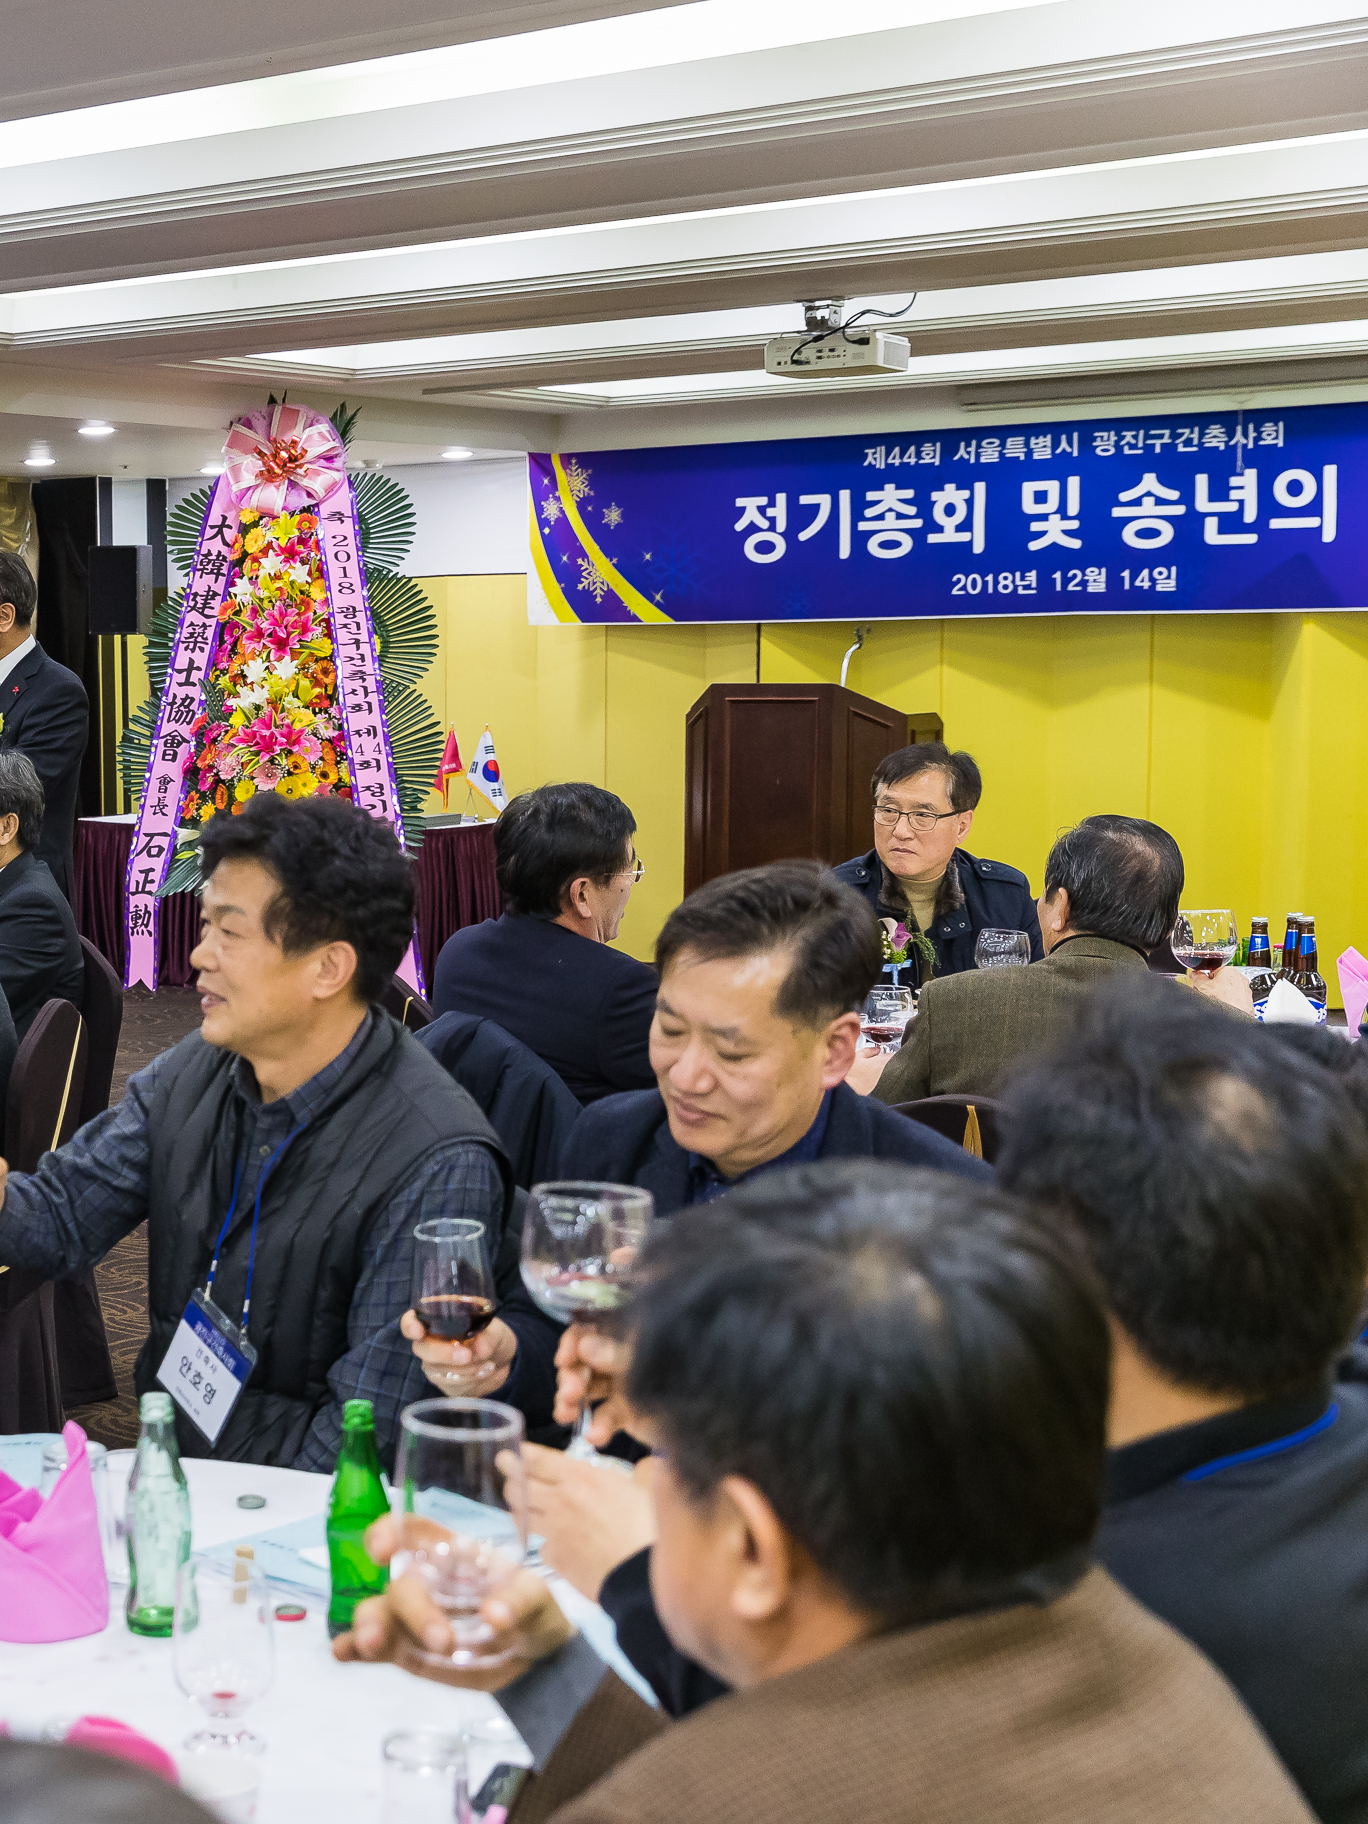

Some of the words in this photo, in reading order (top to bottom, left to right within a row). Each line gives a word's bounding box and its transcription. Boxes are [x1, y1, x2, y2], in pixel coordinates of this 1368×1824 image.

[863, 443, 941, 469] 제44회
[953, 432, 1079, 463] 서울특별시
[1092, 421, 1284, 460] 광진구건축사회
[322, 511, 352, 525] 축
[733, 481, 986, 564] 정기총회
[1021, 475, 1083, 551] 및
[1111, 464, 1338, 550] 송년의
[332, 534, 356, 596] 2018
[951, 570, 1038, 596] 2018년
[1051, 568, 1107, 594] 12월
[1119, 565, 1177, 592] 14일
[159, 514, 233, 763] 大韓建築士協會
[335, 605, 378, 716] 광진구건축사회
[350, 724, 383, 774] 제44회
[150, 773, 176, 816] 會長
